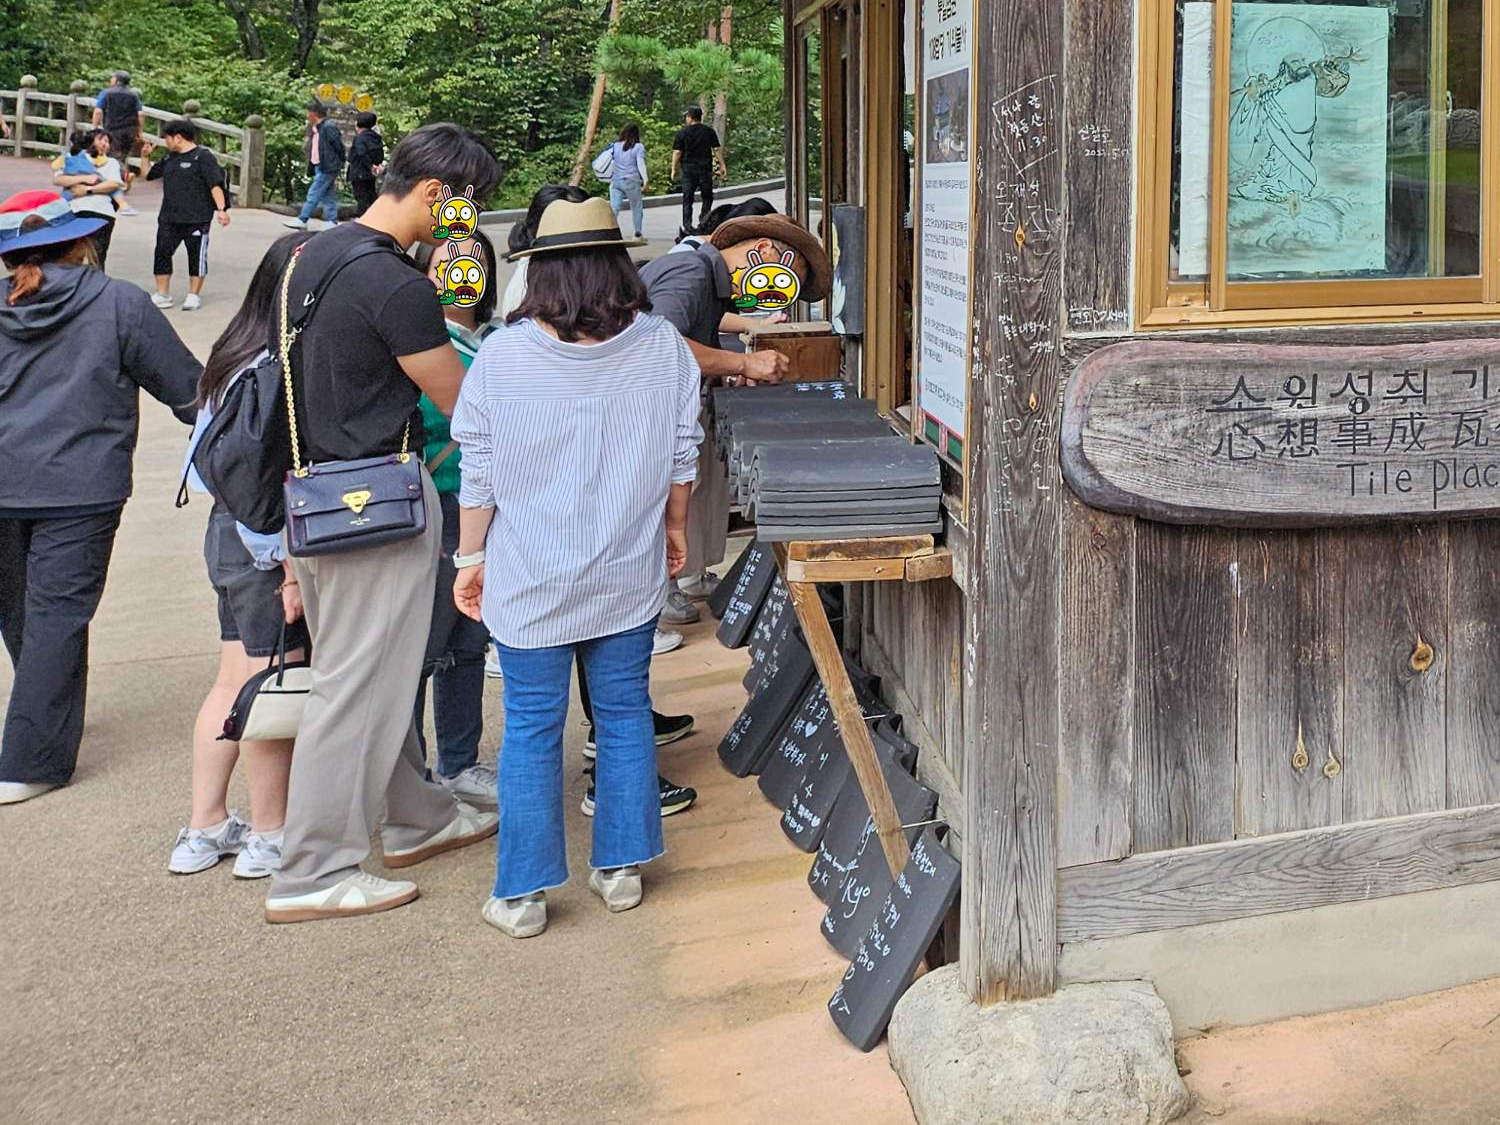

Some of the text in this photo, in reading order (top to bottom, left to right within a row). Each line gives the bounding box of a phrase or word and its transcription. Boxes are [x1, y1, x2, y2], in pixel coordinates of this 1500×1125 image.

[1205, 369, 1428, 415] 소원성취
[1211, 411, 1429, 461] 心想事成
[1336, 461, 1413, 496] Tile
[841, 876, 871, 919] Kyo
